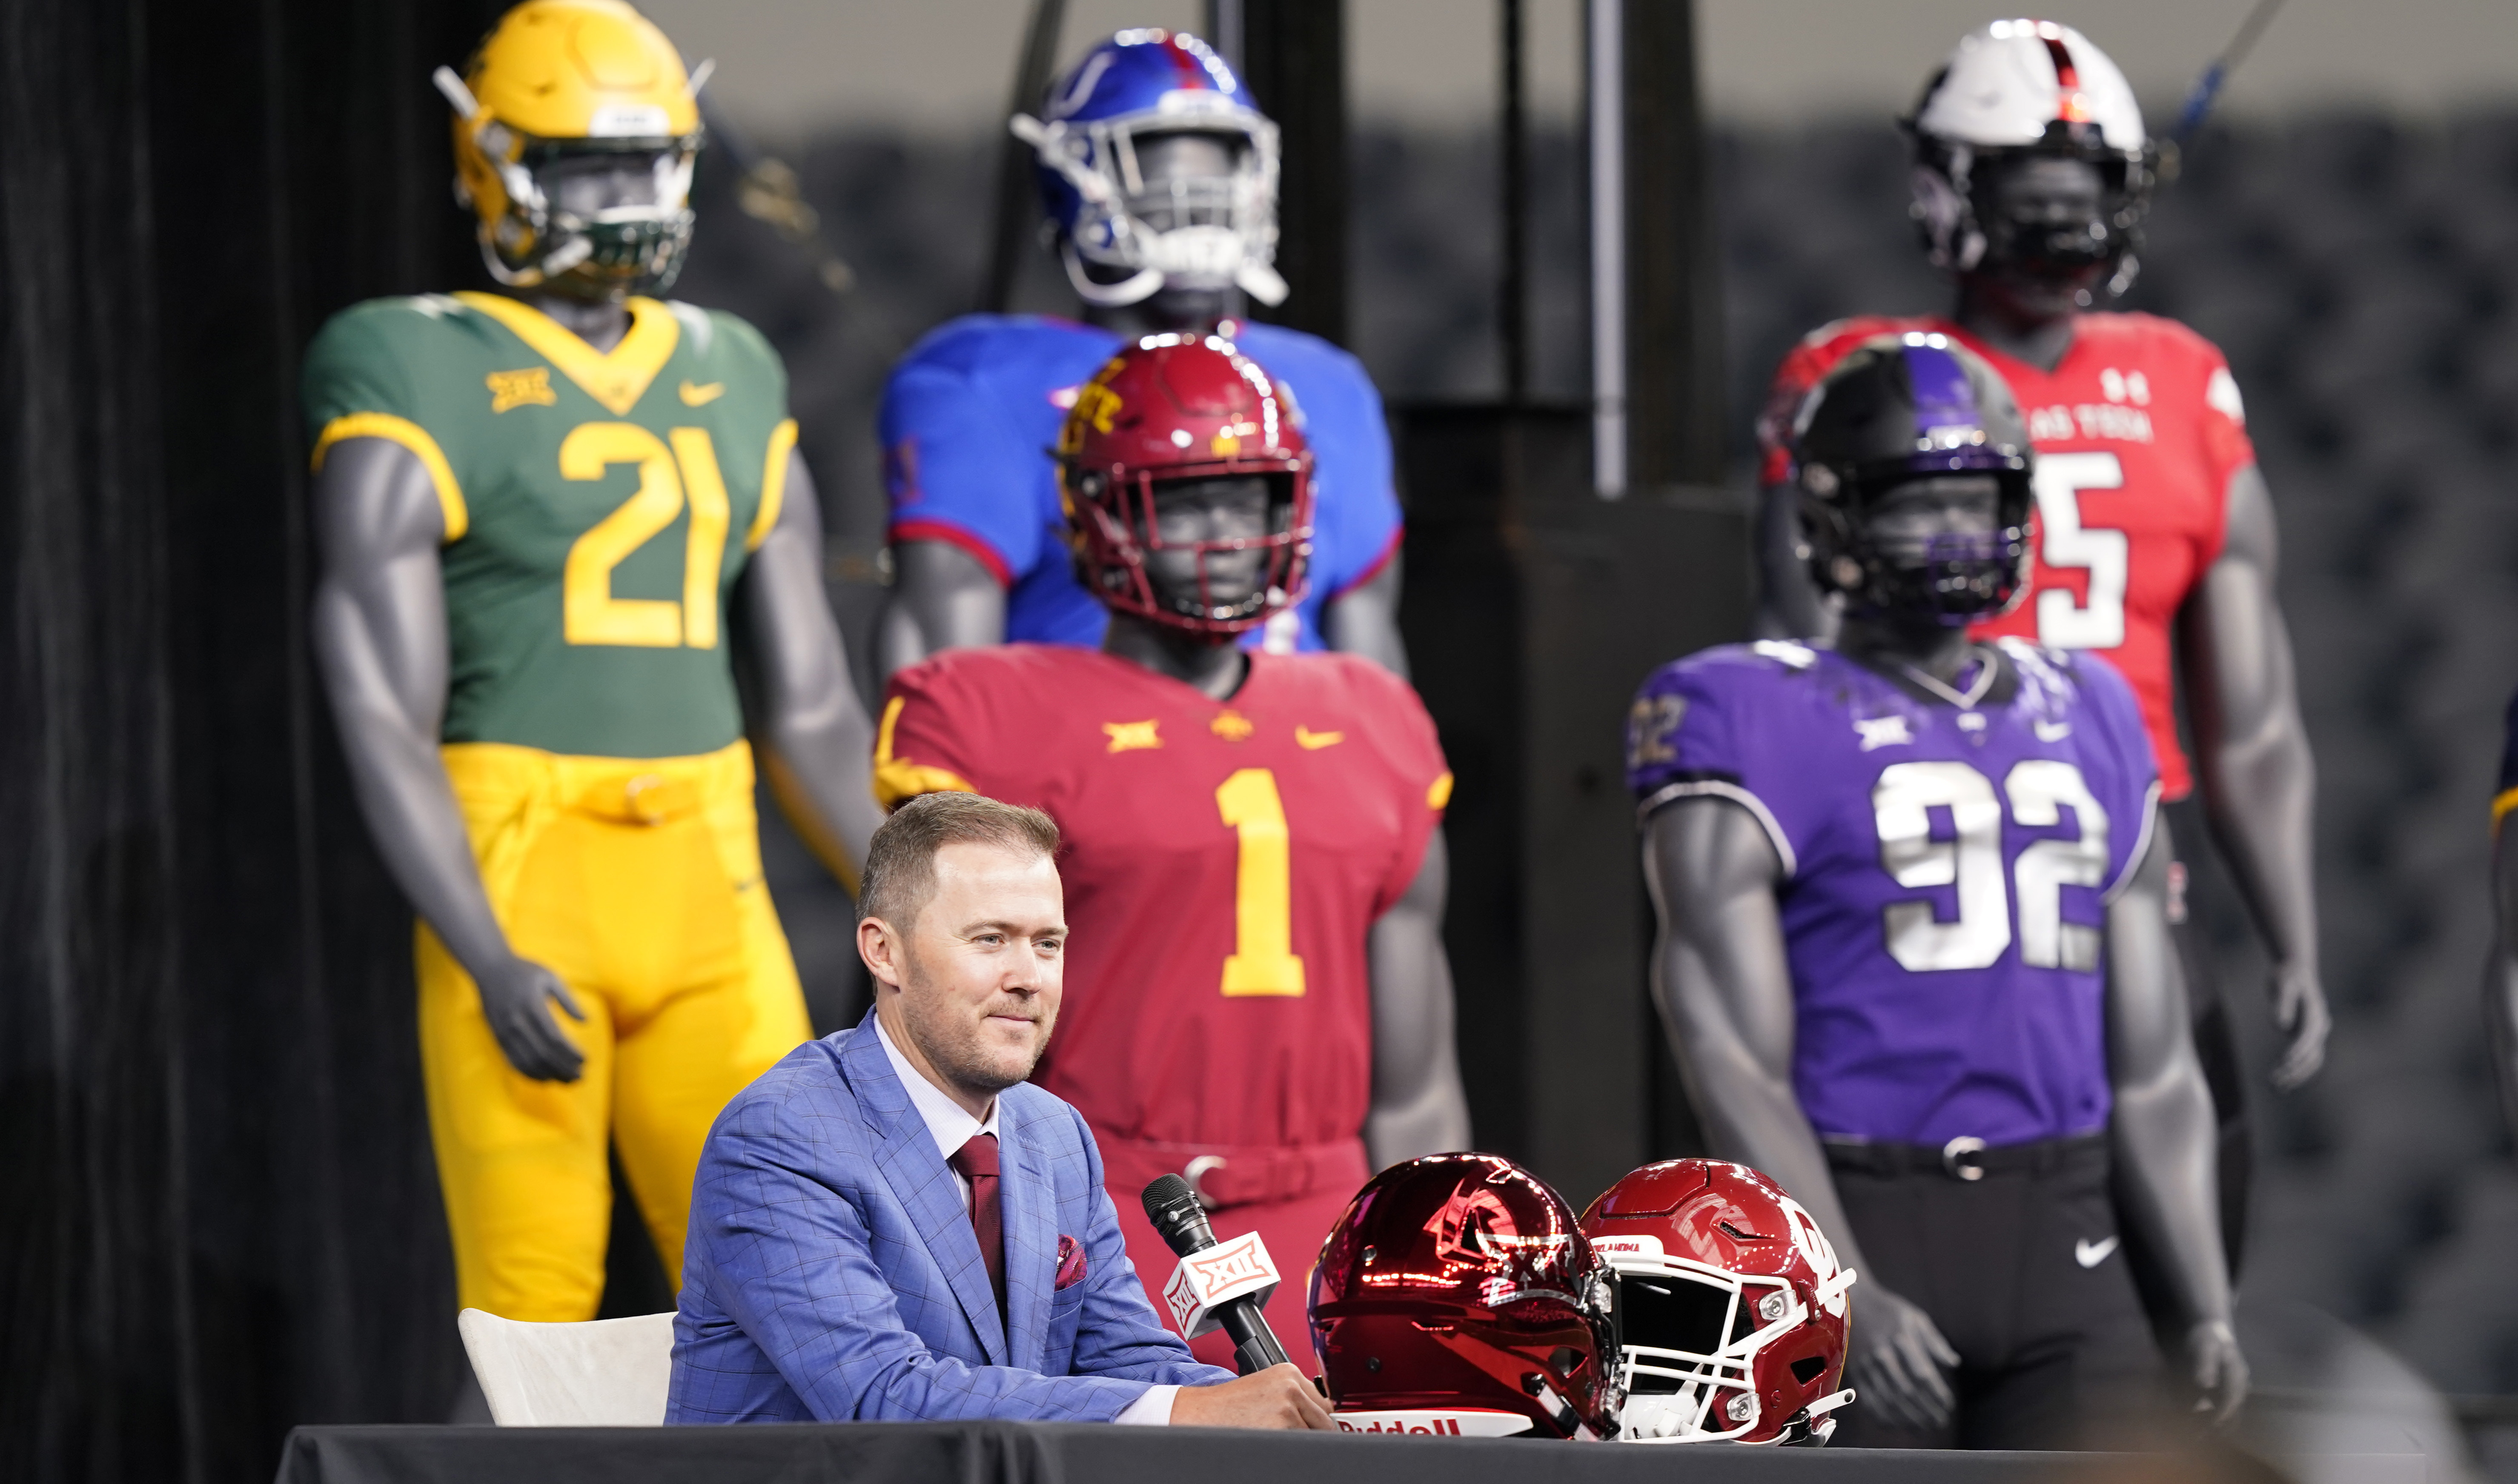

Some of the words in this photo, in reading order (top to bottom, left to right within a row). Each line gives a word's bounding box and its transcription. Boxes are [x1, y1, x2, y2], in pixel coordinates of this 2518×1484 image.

[559, 421, 730, 650] 21
[2033, 451, 2128, 649] 5
[1215, 768, 1306, 997] 1
[1874, 760, 2110, 974] 92
[1166, 1268, 1201, 1333] XII
[1191, 1239, 1271, 1299] XII
[1337, 1419, 1461, 1436] Rddell
